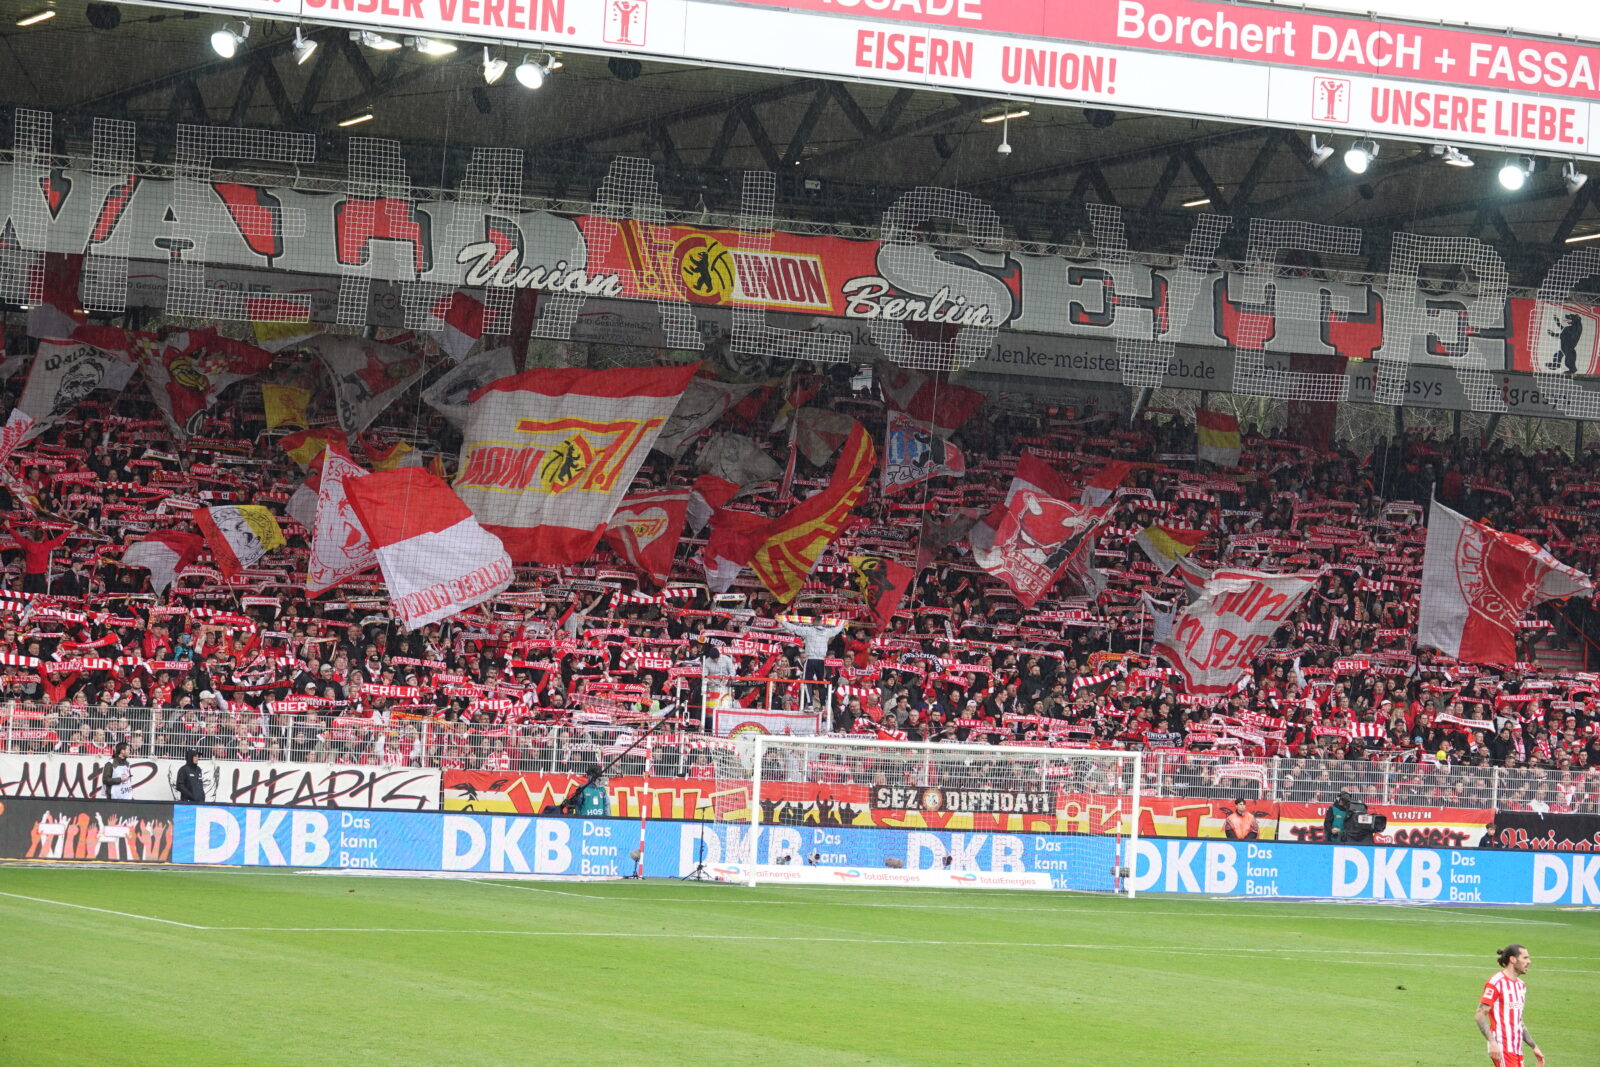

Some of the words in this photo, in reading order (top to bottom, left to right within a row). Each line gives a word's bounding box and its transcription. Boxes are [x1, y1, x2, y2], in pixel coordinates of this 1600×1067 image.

[1117, 0, 1296, 57] Borchert
[1311, 24, 1422, 70] DACH
[1435, 48, 1456, 73] +
[1469, 42, 1600, 91] FASSA
[855, 29, 974, 80] EISERN
[1001, 46, 1118, 95] UNION!
[1371, 86, 1488, 134] UNSERE
[1495, 100, 1585, 145] LIEBE.
[457, 242, 624, 297] Union
[736, 252, 830, 305] UNION
[843, 275, 993, 327] Berlin
[341, 811, 371, 829] Das
[1392, 811, 1432, 820] YOUTH
[194, 807, 331, 867] DKB
[583, 820, 612, 838] Das
[814, 829, 841, 846] Das
[340, 830, 378, 849] kann
[441, 815, 573, 874] DKB
[581, 838, 618, 858] kann
[1035, 836, 1062, 853] Das
[340, 851, 378, 869] Bank
[906, 831, 1026, 874] DKB
[1247, 844, 1272, 859] Das
[1451, 852, 1476, 867] Das
[581, 858, 619, 877] Bank
[1034, 854, 1068, 871] kann
[1125, 840, 1239, 894] DKB
[1246, 863, 1279, 878] kann
[863, 872, 922, 884] TotalEnergies
[980, 876, 1038, 887] TotalEnergies
[1332, 847, 1443, 900] DKB
[1450, 870, 1481, 885] kann
[1245, 880, 1279, 896] Bank
[1450, 887, 1482, 902] Bank
